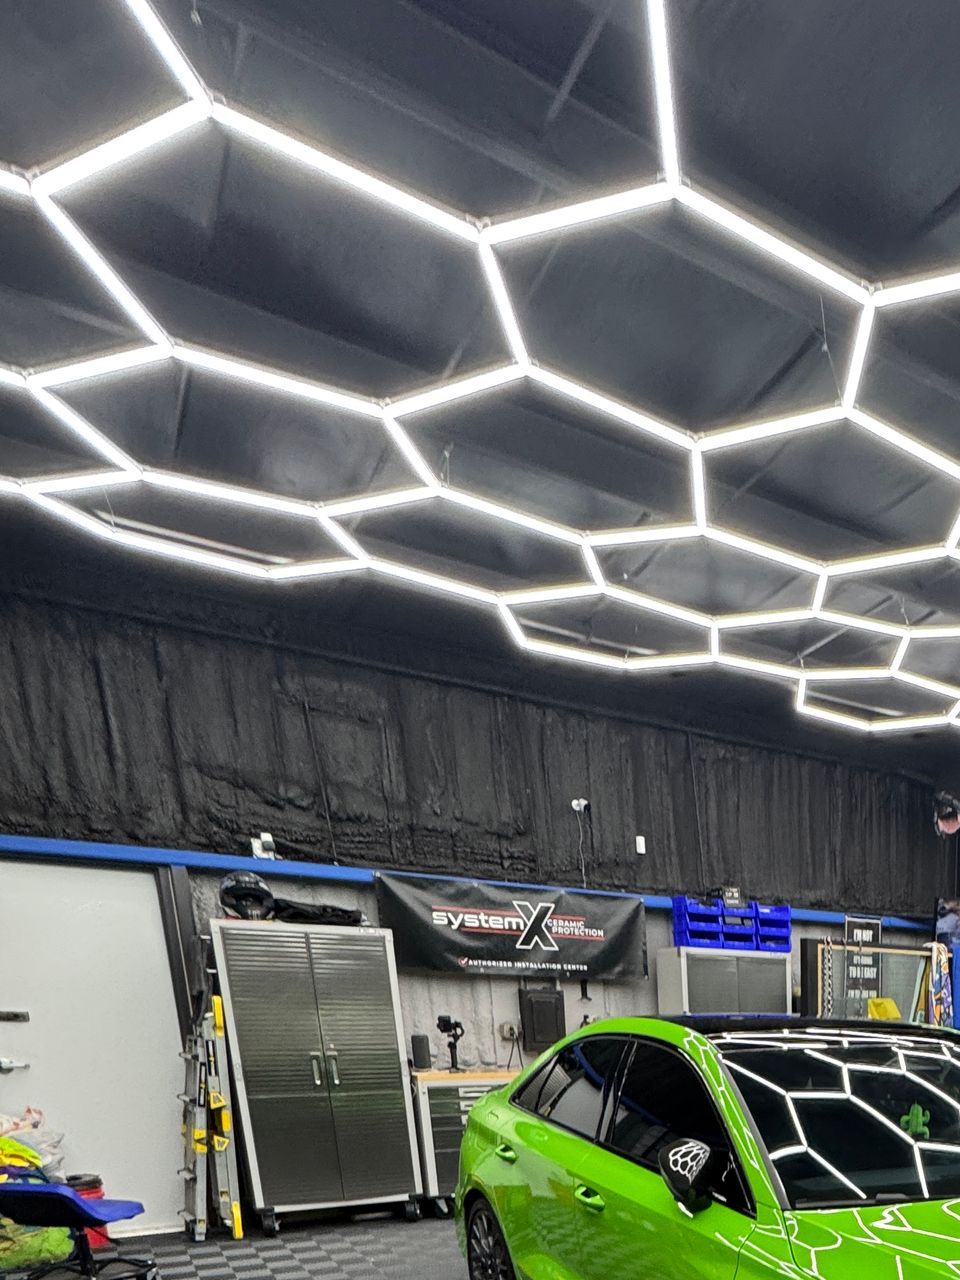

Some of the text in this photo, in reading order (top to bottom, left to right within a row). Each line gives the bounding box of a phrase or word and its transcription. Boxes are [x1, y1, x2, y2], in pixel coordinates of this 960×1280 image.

[547, 919, 585, 929] CERAMIC
[551, 927, 604, 938] PROTECTION
[468, 959, 588, 972] AUTHORIZED INSTALLATION CENTER
